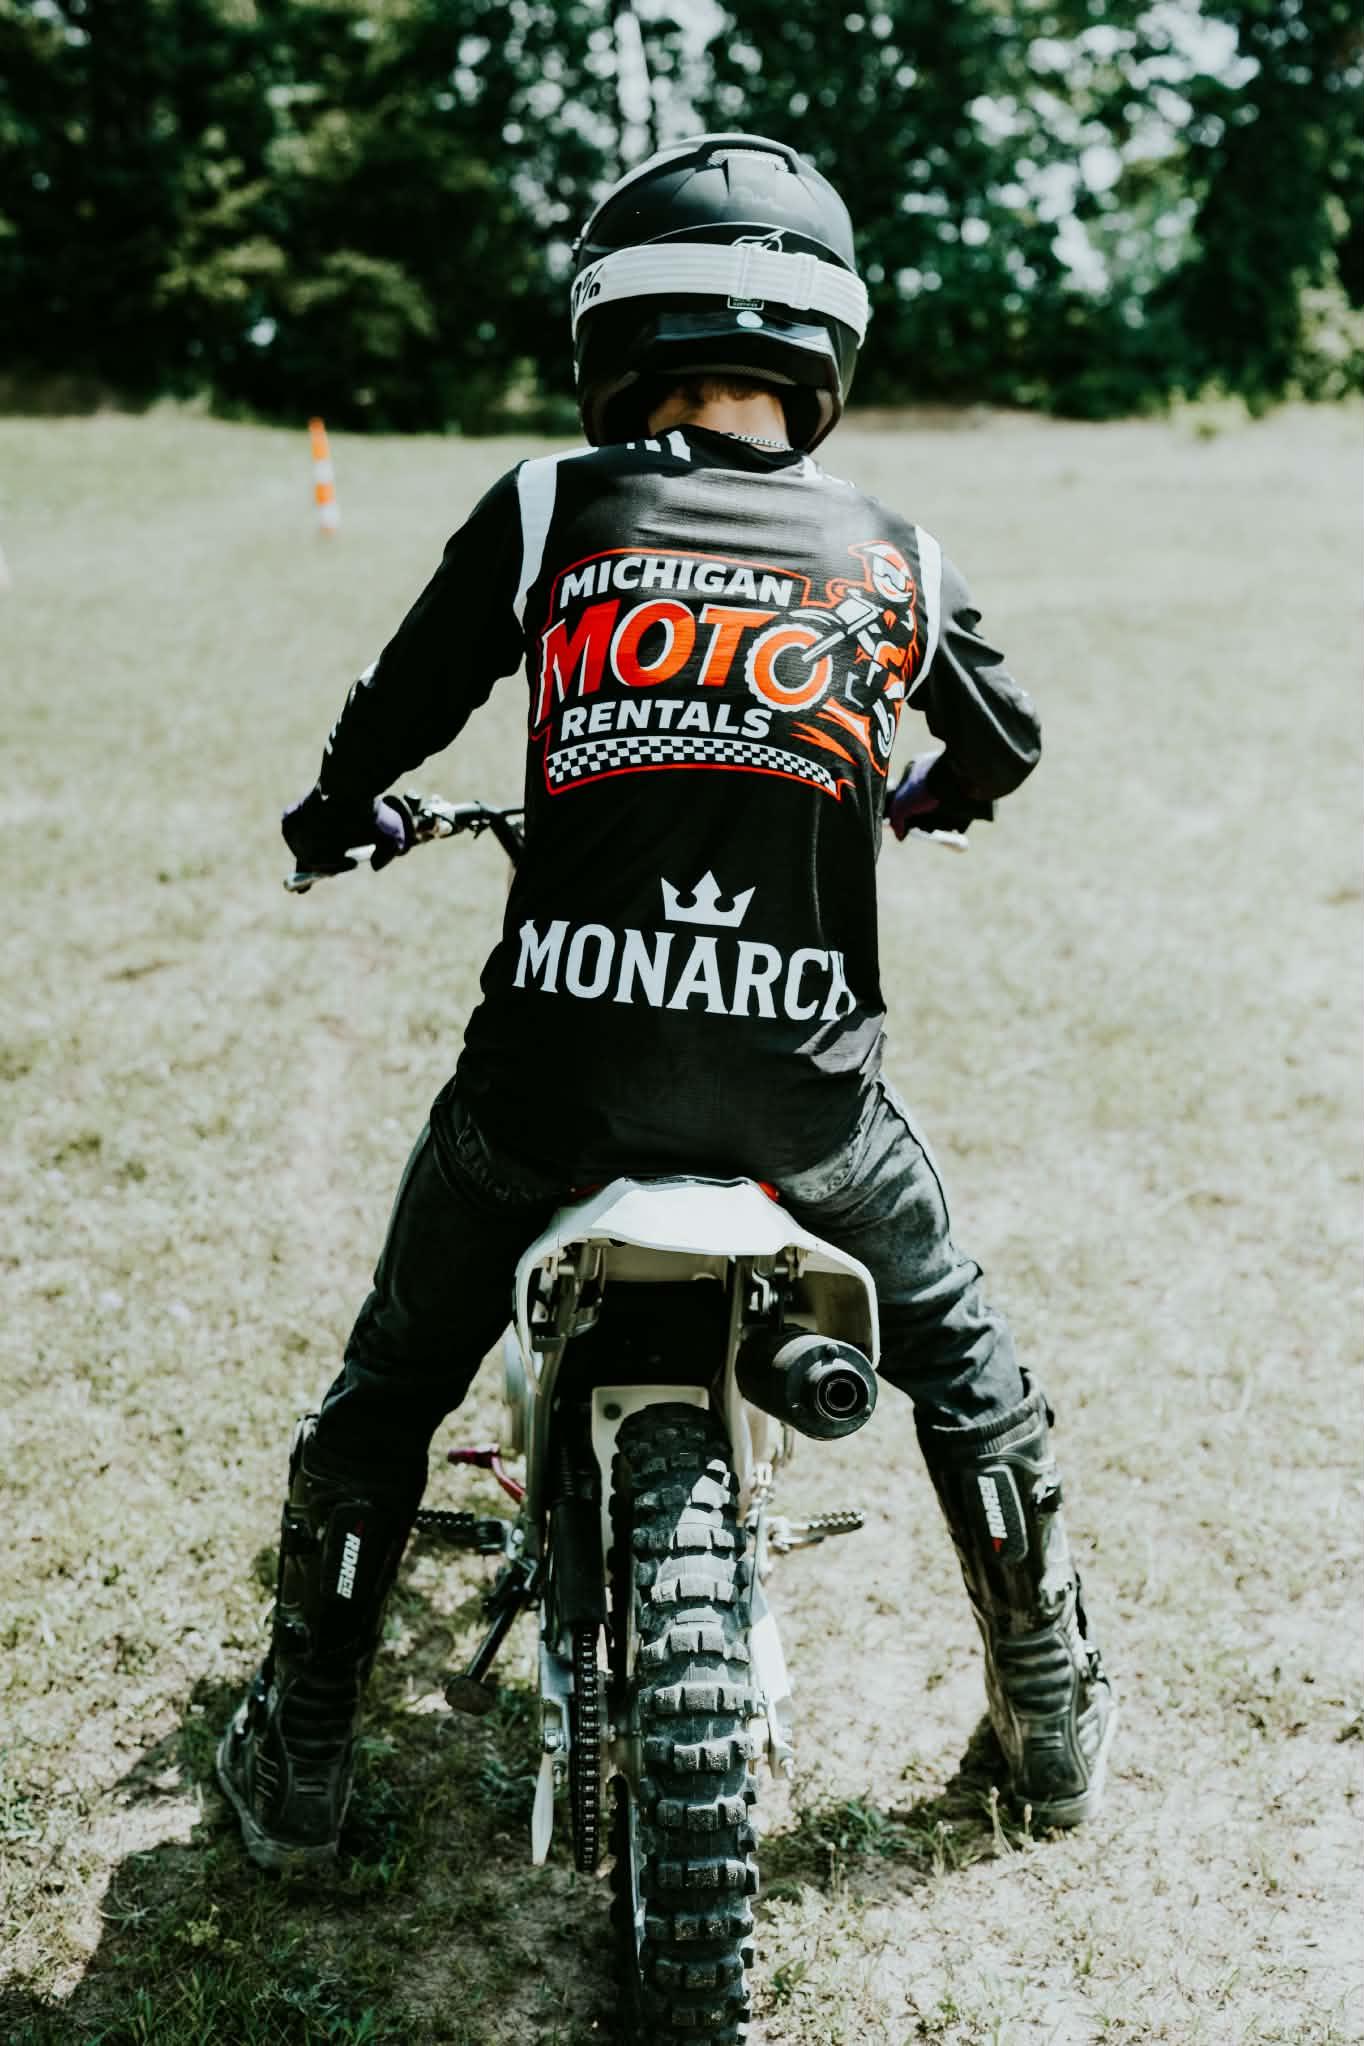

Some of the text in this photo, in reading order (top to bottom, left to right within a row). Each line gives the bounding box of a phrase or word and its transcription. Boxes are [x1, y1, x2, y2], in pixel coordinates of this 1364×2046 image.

[559, 556, 793, 608] MICHIGAN
[534, 599, 833, 728] MOTO
[560, 699, 773, 742] RENTALS
